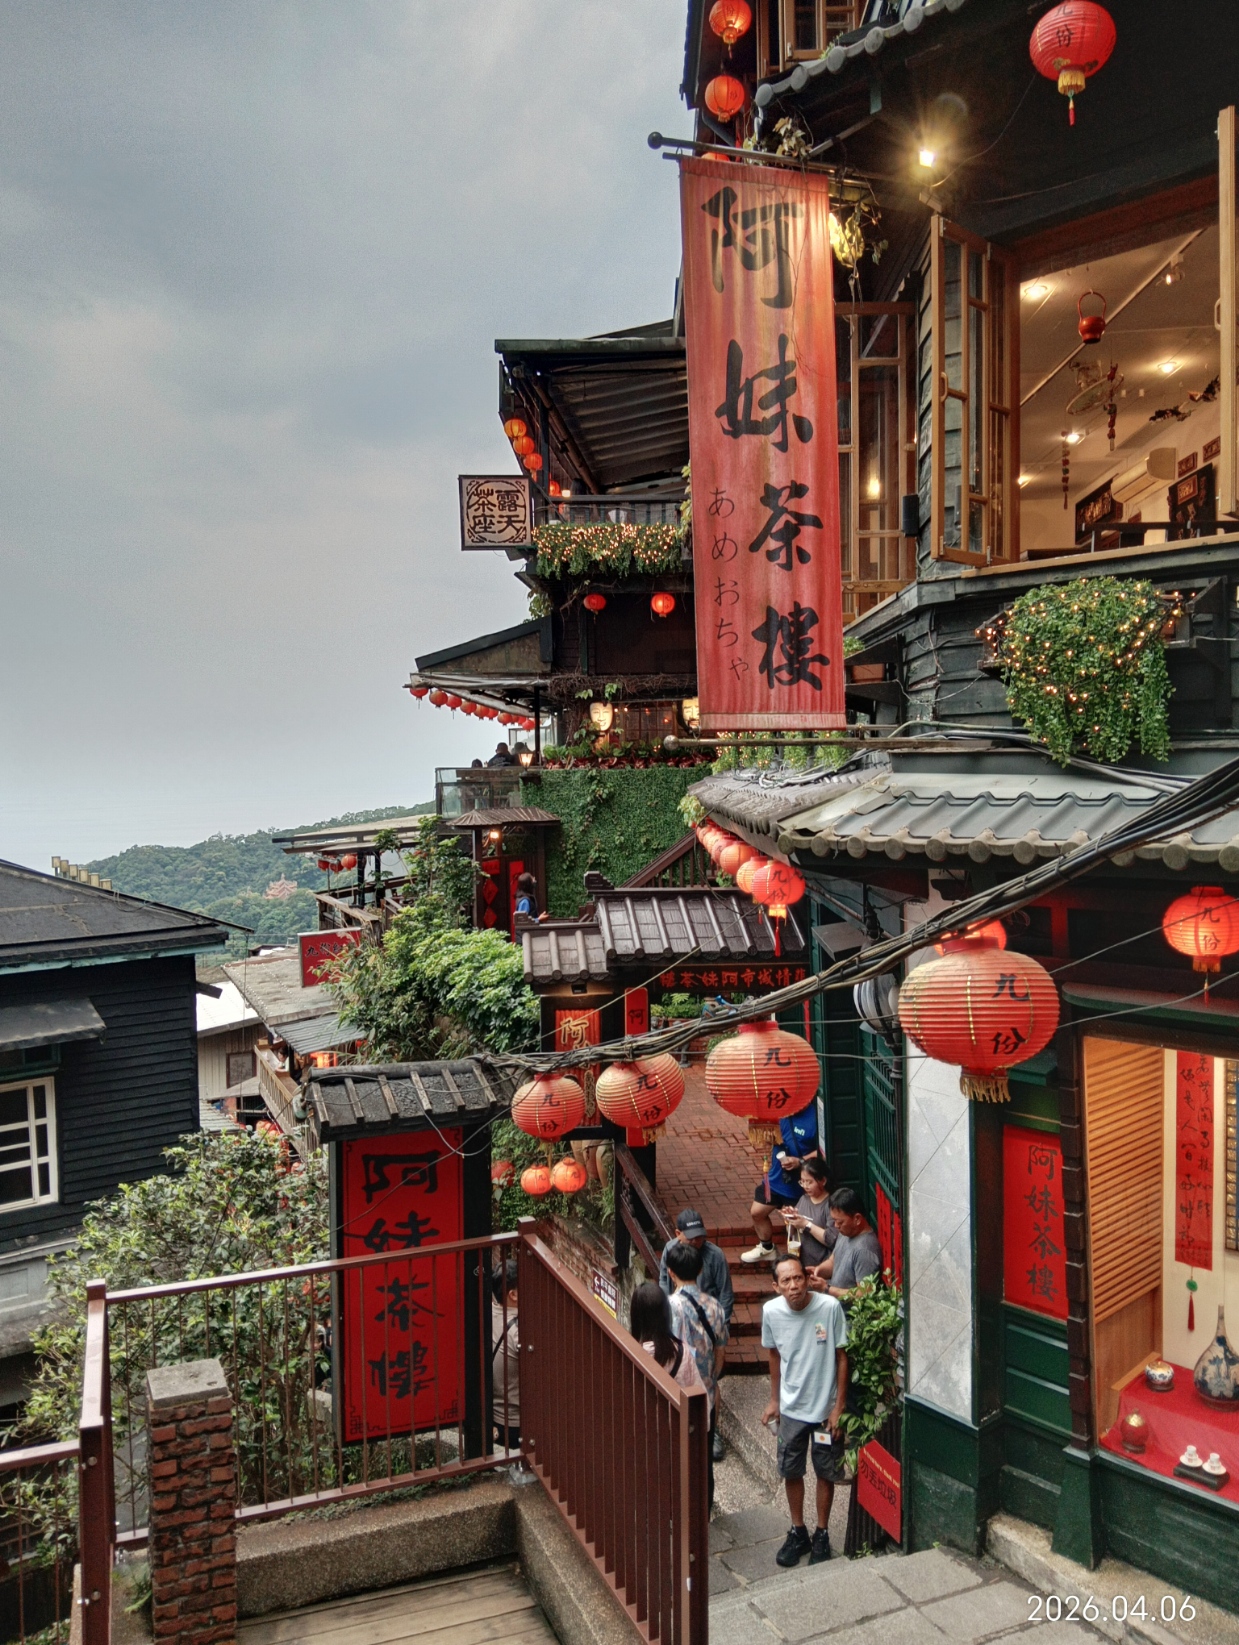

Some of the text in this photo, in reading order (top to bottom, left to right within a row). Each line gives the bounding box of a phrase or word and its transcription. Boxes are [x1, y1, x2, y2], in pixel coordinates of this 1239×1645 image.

[1054, 4, 1074, 48] 九份
[701, 186, 831, 691] 阿妹茶樓
[770, 869, 788, 902] 九份
[1201, 906, 1221, 952] 九份
[990, 973, 1031, 1056] 九份
[636, 1073, 662, 1122] 九份
[764, 1047, 792, 1109] 九份
[541, 1093, 560, 1133] 九份
[1024, 1144, 1061, 1302] 阿妹茶樓
